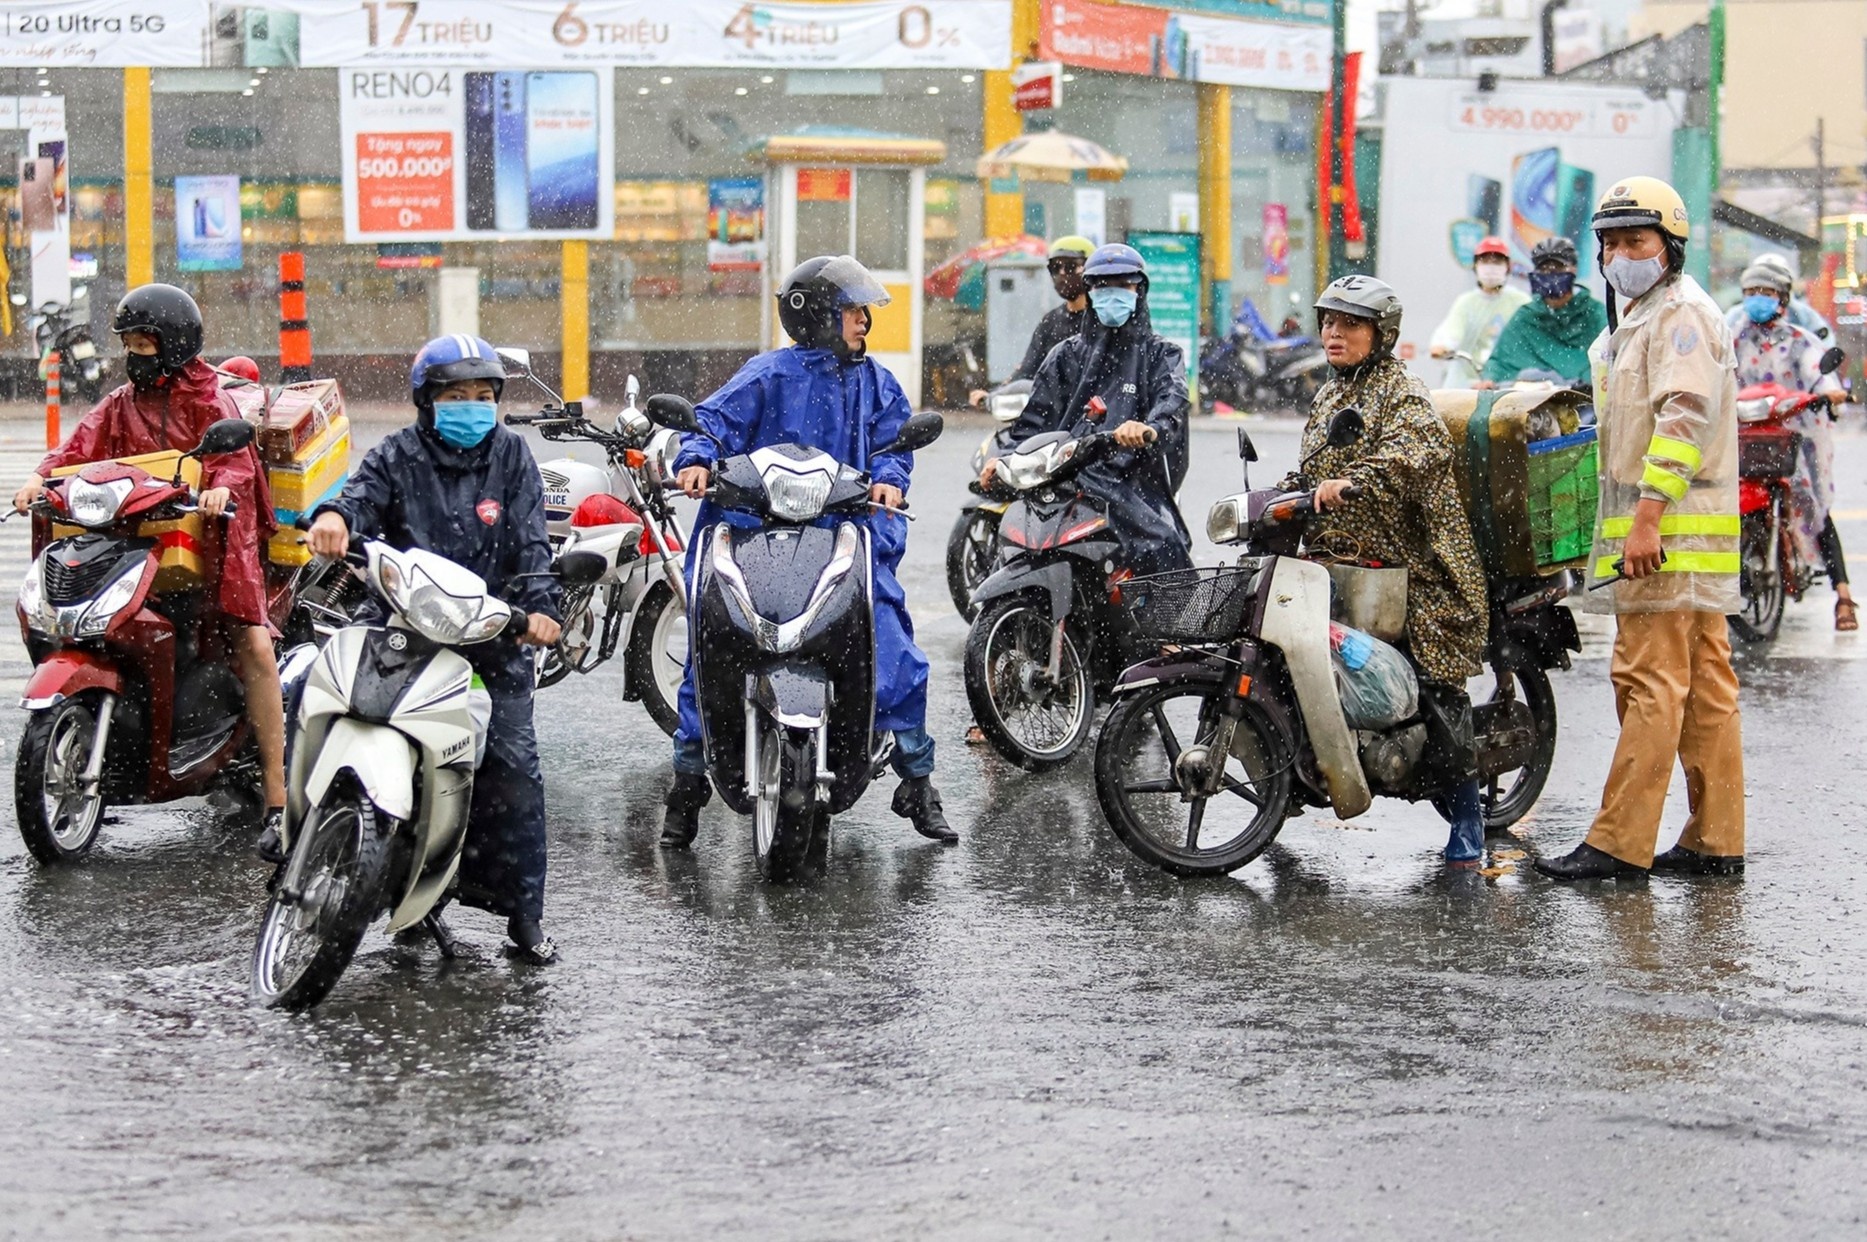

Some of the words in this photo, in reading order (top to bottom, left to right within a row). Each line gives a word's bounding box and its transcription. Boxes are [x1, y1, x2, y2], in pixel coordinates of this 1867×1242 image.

[19, 15, 49, 33] 20
[58, 14, 121, 34] Ultra
[130, 15, 165, 33] 5G
[362, 2, 418, 47] 17
[552, 1, 588, 46] 6
[724, 4, 762, 48] 4
[352, 71, 452, 99] RENO4
[543, 494, 567, 505] OLICE
[442, 735, 470, 759] YAMAHA
